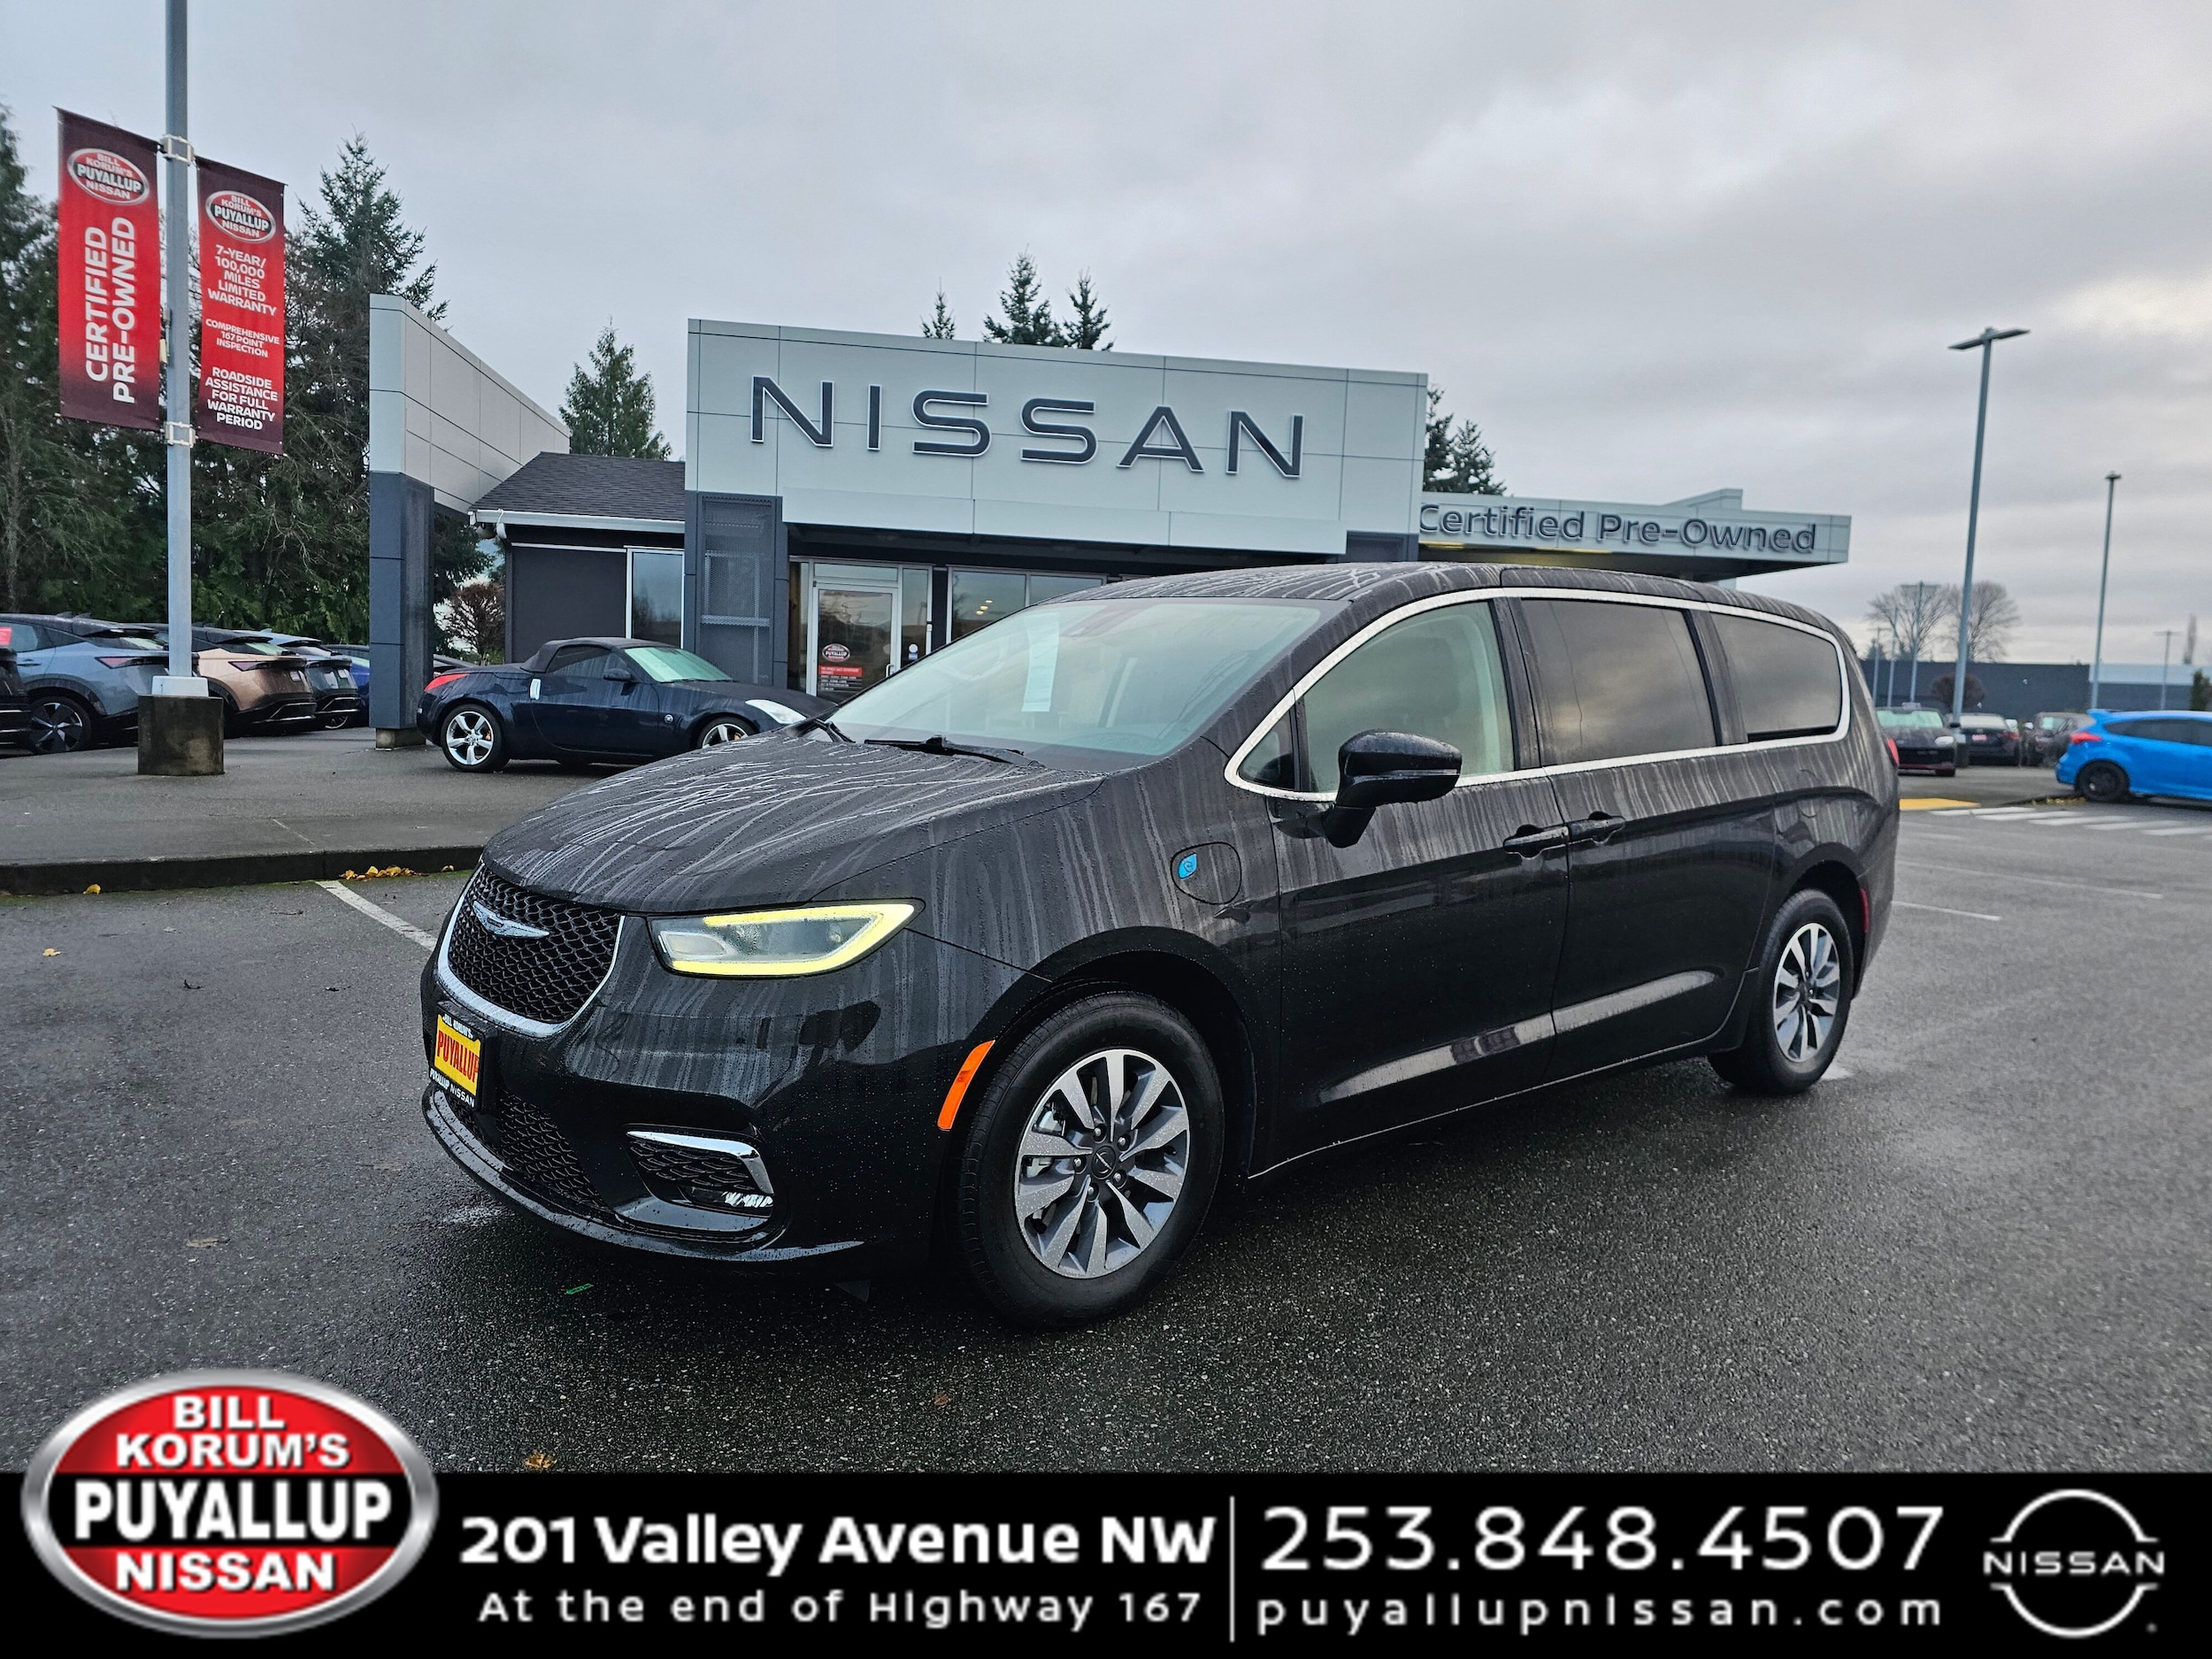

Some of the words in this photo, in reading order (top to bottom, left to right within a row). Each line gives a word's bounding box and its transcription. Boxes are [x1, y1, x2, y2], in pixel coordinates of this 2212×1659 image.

[86, 157, 134, 177] KORUM'S
[96, 152, 121, 166] BILL
[77, 163, 142, 193] PUYALLUP
[86, 180, 131, 199] NISSAN
[221, 199, 262, 217] KORUM'S
[231, 196, 251, 207] BILL
[214, 205, 269, 231] PUYALLUP
[222, 220, 260, 237] NISSAN
[216, 244, 266, 268] 7-YEAR/
[215, 257, 265, 279] 100,000
[224, 270, 260, 289] MILES
[207, 288, 277, 316] WARRANTY
[218, 280, 265, 302] LIMITED
[85, 227, 108, 382] CERTIFIED
[111, 217, 135, 403] PRE-OWNED
[205, 319, 280, 344] COMPREHENSIVE
[221, 331, 235, 342] 167
[236, 336, 265, 349] POINT
[217, 338, 268, 357] INSPECTION
[205, 377, 279, 401] ASSISTANCE
[212, 366, 273, 389] ROADSIDE
[207, 399, 275, 422] WARRANTY
[211, 389, 238, 403] FOR
[239, 395, 269, 411] FULL
[216, 412, 263, 430] PERIOD
[751, 374, 1303, 478] NISSAN
[1419, 503, 1586, 541] Certified
[1597, 512, 1817, 553] Pre-Owned
[437, 1030, 480, 1083] PUYALLUP
[449, 1083, 475, 1108] NISSAN
